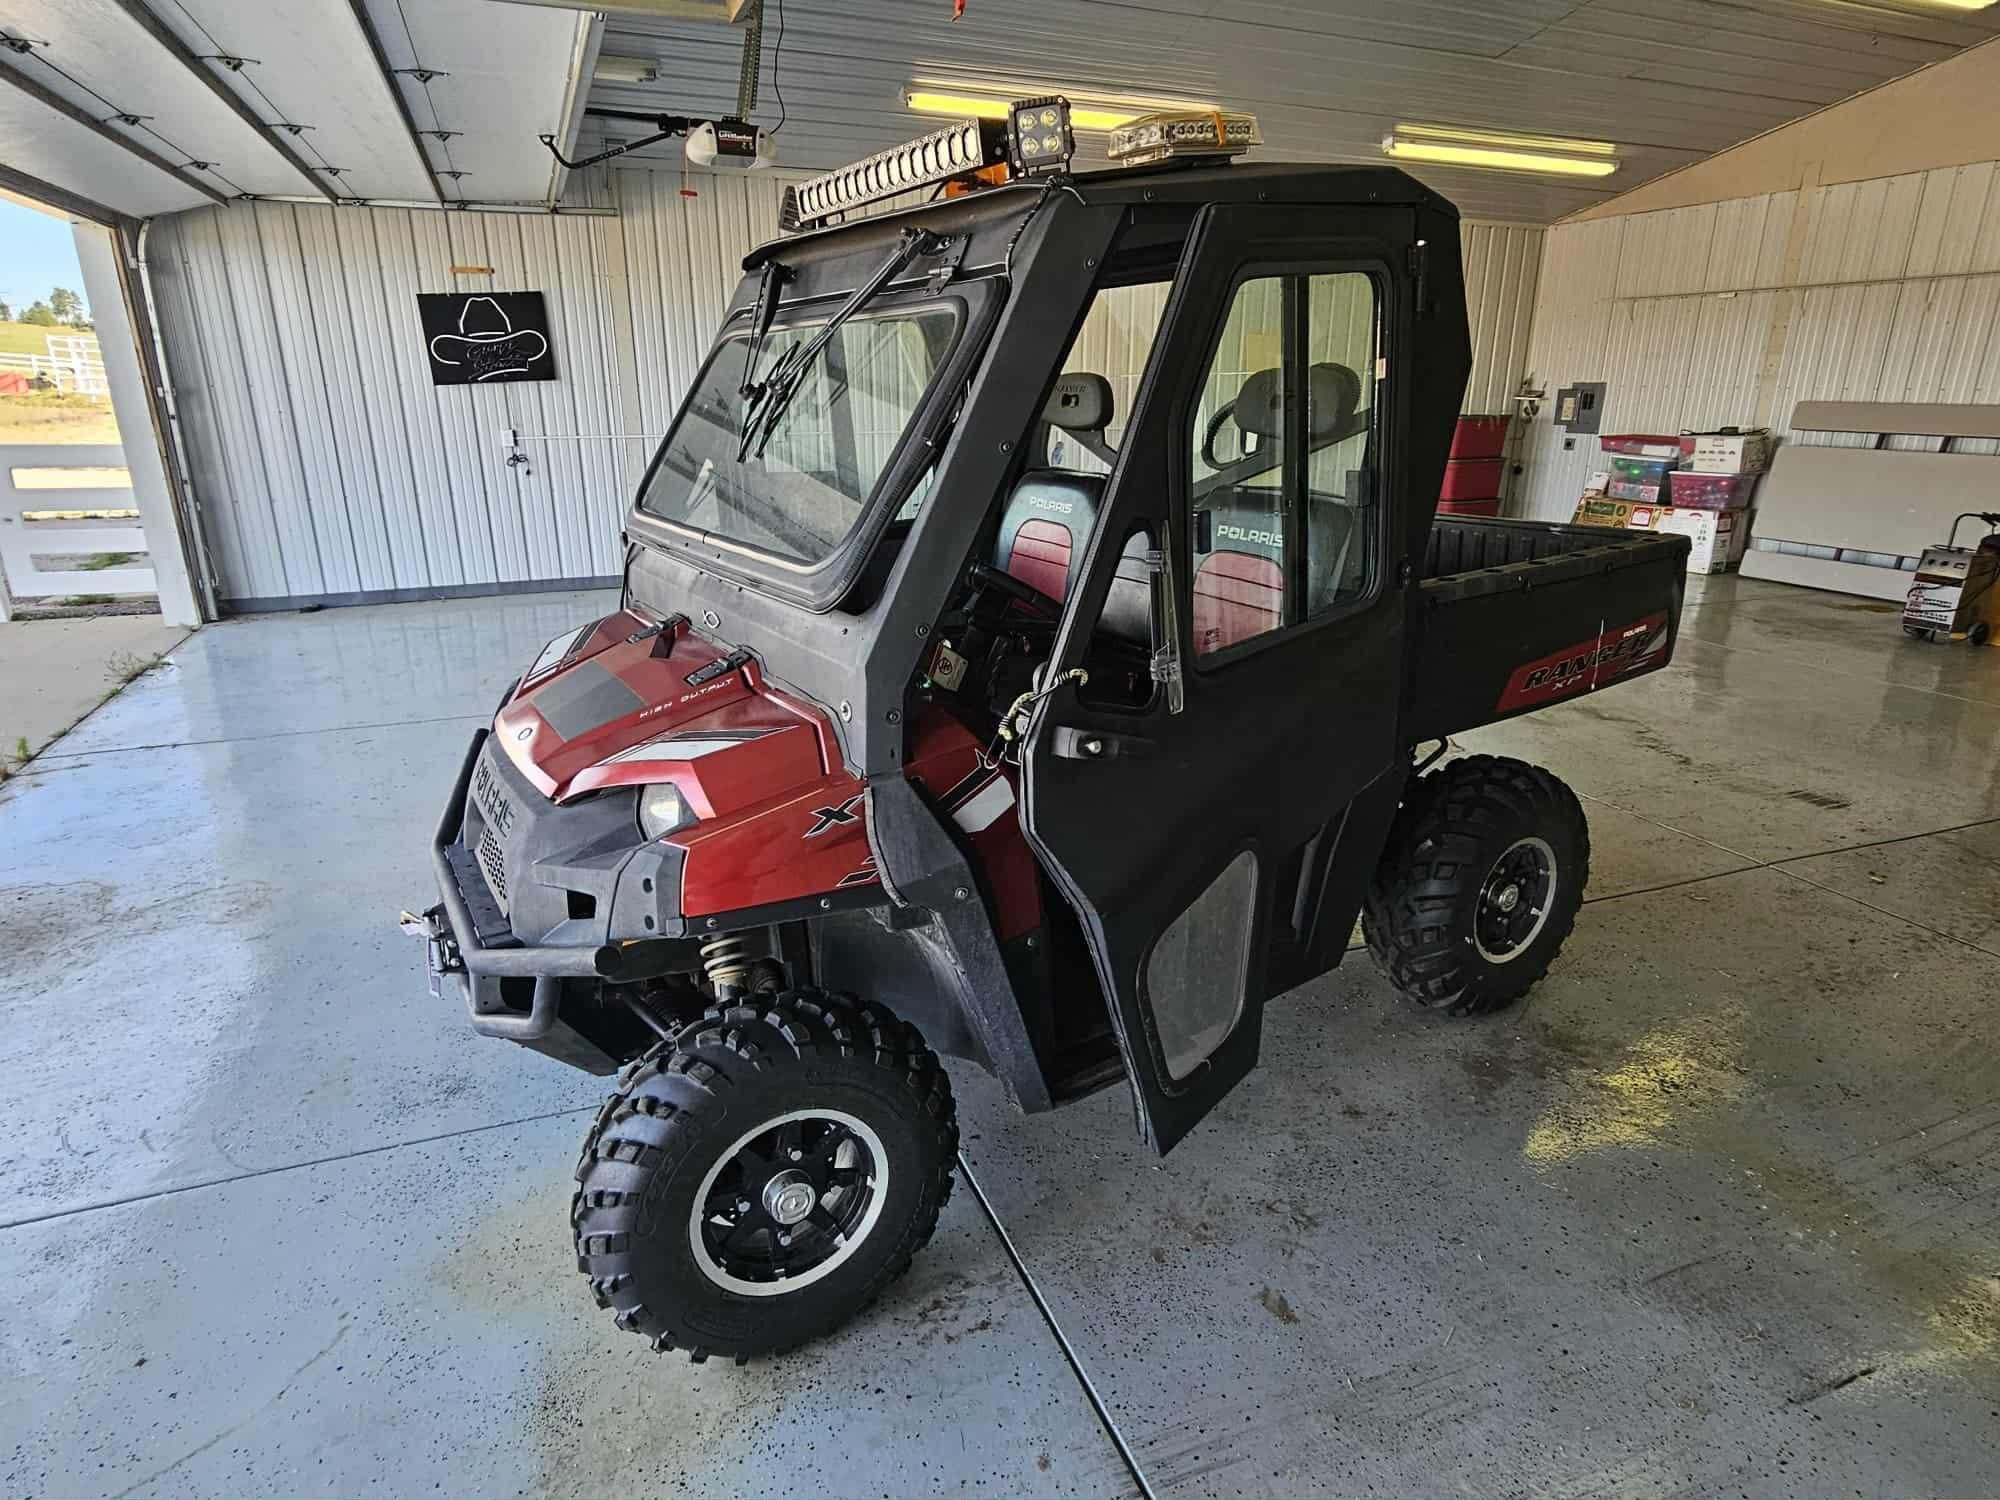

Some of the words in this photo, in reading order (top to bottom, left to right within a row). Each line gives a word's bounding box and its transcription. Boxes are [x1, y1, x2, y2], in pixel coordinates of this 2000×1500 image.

[1030, 496, 1073, 514] POLARIS
[1217, 524, 1283, 547] POLARIS
[1552, 673, 1583, 691] XP
[639, 701, 673, 719] HIGH
[680, 678, 734, 703] OUTPUT
